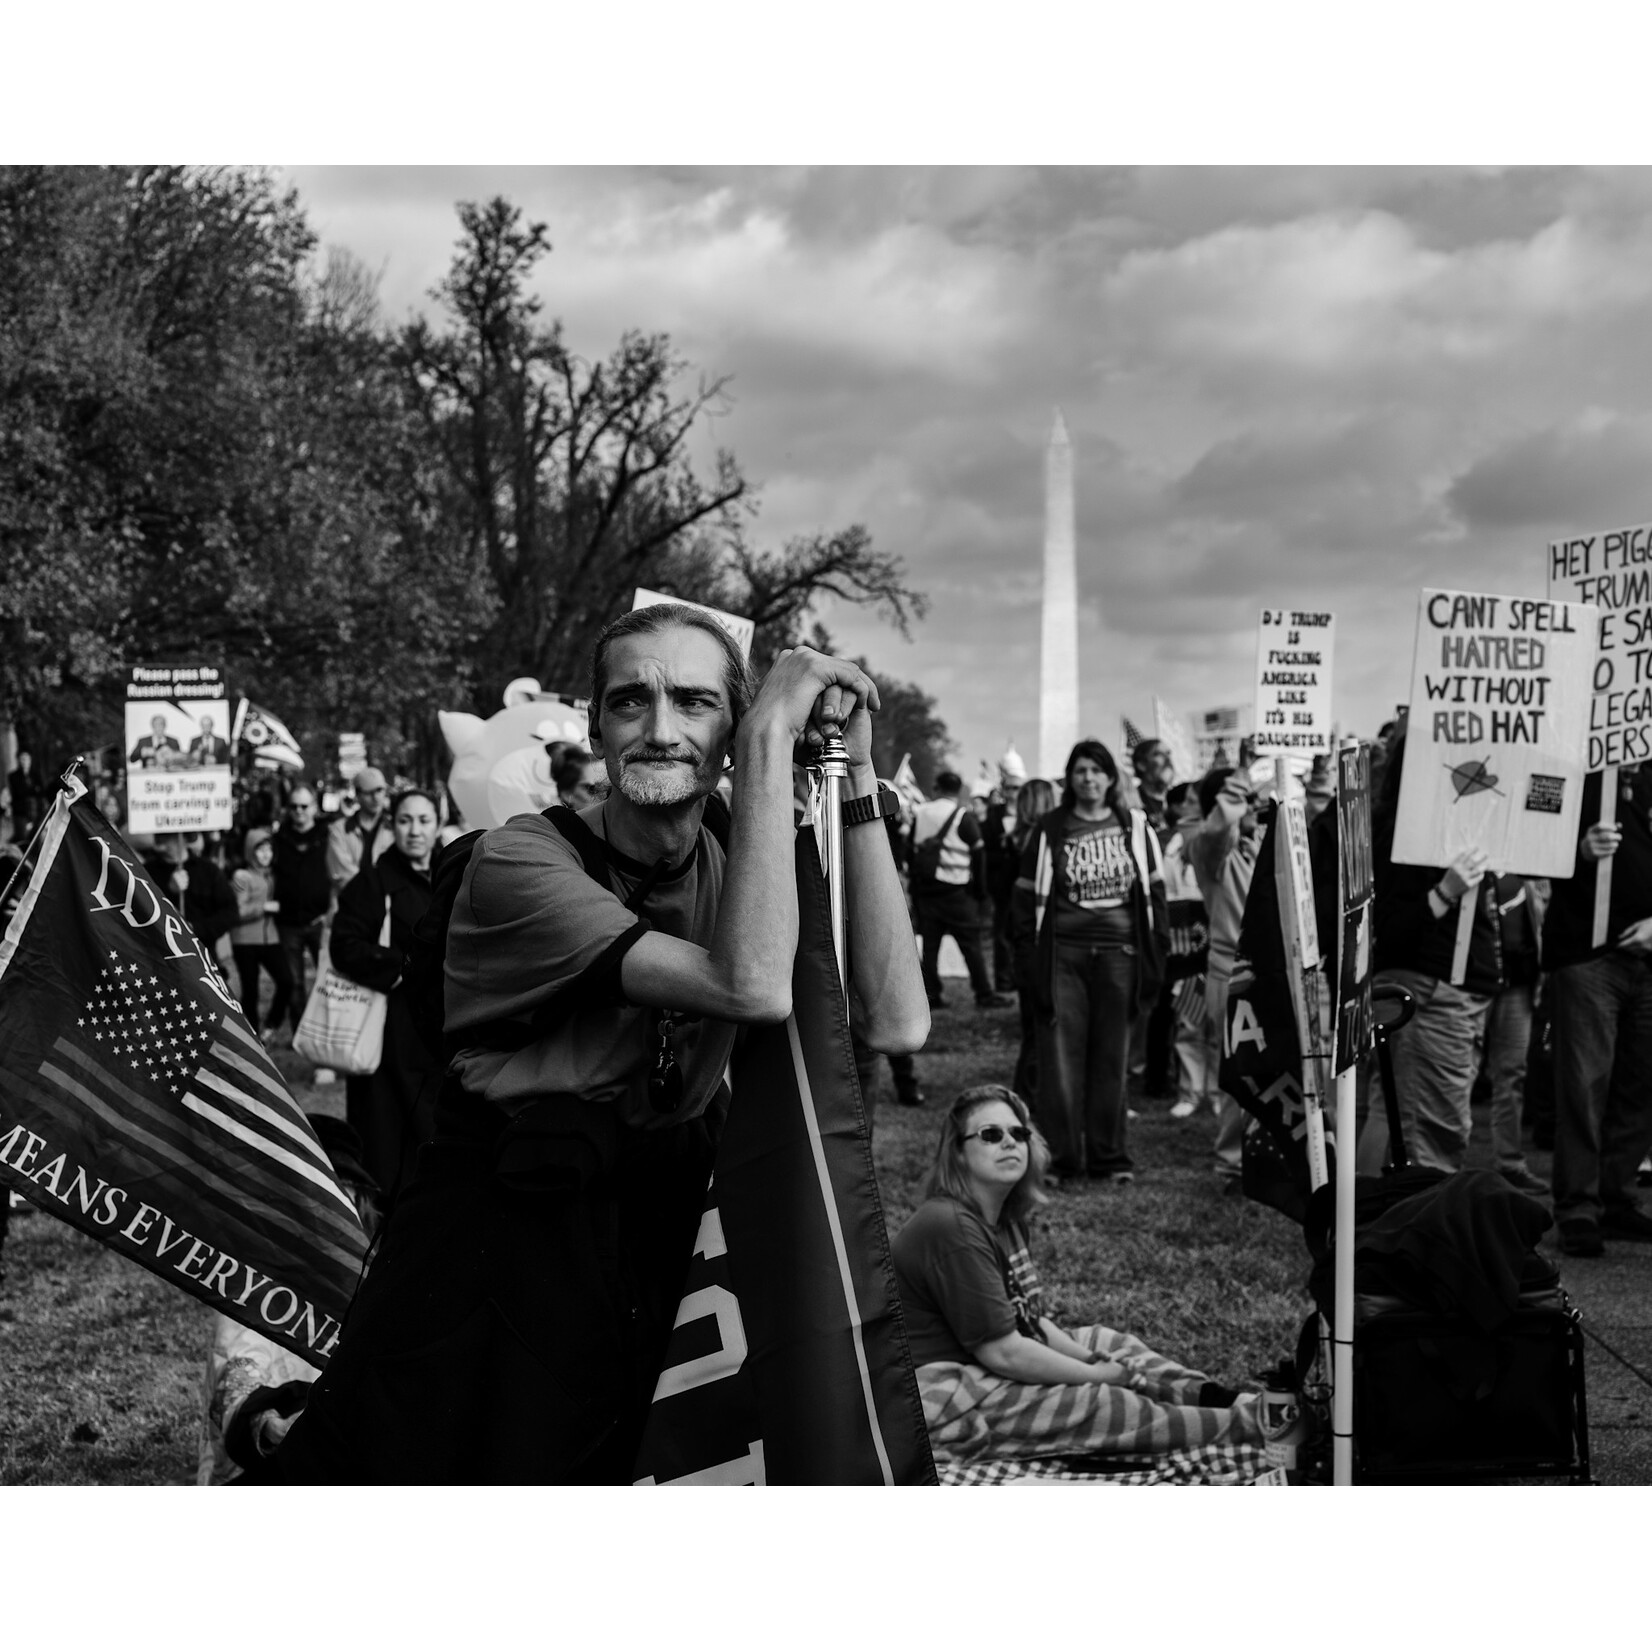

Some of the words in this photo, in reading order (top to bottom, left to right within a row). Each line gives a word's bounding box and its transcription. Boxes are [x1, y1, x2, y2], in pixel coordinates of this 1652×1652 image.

[1552, 536, 1596, 581] HEY
[1603, 528, 1652, 570] PIG
[1290, 611, 1332, 627] TRUMP
[1428, 592, 1501, 629] CANT
[1508, 600, 1576, 633] SPELL
[1600, 614, 1616, 650] E
[1622, 606, 1652, 645] SA
[1288, 631, 1300, 645] IS
[1268, 650, 1321, 665] FUCKING
[1441, 635, 1545, 670] HATRED
[132, 666, 171, 682] Please
[172, 668, 199, 683] pass
[199, 666, 219, 681] the
[1261, 671, 1317, 686] AMERICA
[1593, 657, 1614, 691] O
[127, 683, 173, 697] Russian
[173, 682, 225, 699] dressing!
[1277, 691, 1306, 704] LIKE
[1425, 674, 1551, 706] WITHOUT
[1590, 687, 1652, 732] LEGA
[1293, 711, 1313, 726] HIS
[1433, 710, 1484, 744] RED
[1491, 710, 1546, 744] HAT
[1258, 732, 1325, 747] DAUGHTER
[1589, 724, 1651, 769] DERS
[144, 780, 174, 796] Stop
[178, 778, 216, 793] Trump
[131, 797, 160, 811] from
[163, 796, 211, 810] carving
[154, 811, 209, 828] Ukraine!
[0, 1124, 129, 1226] MEANS
